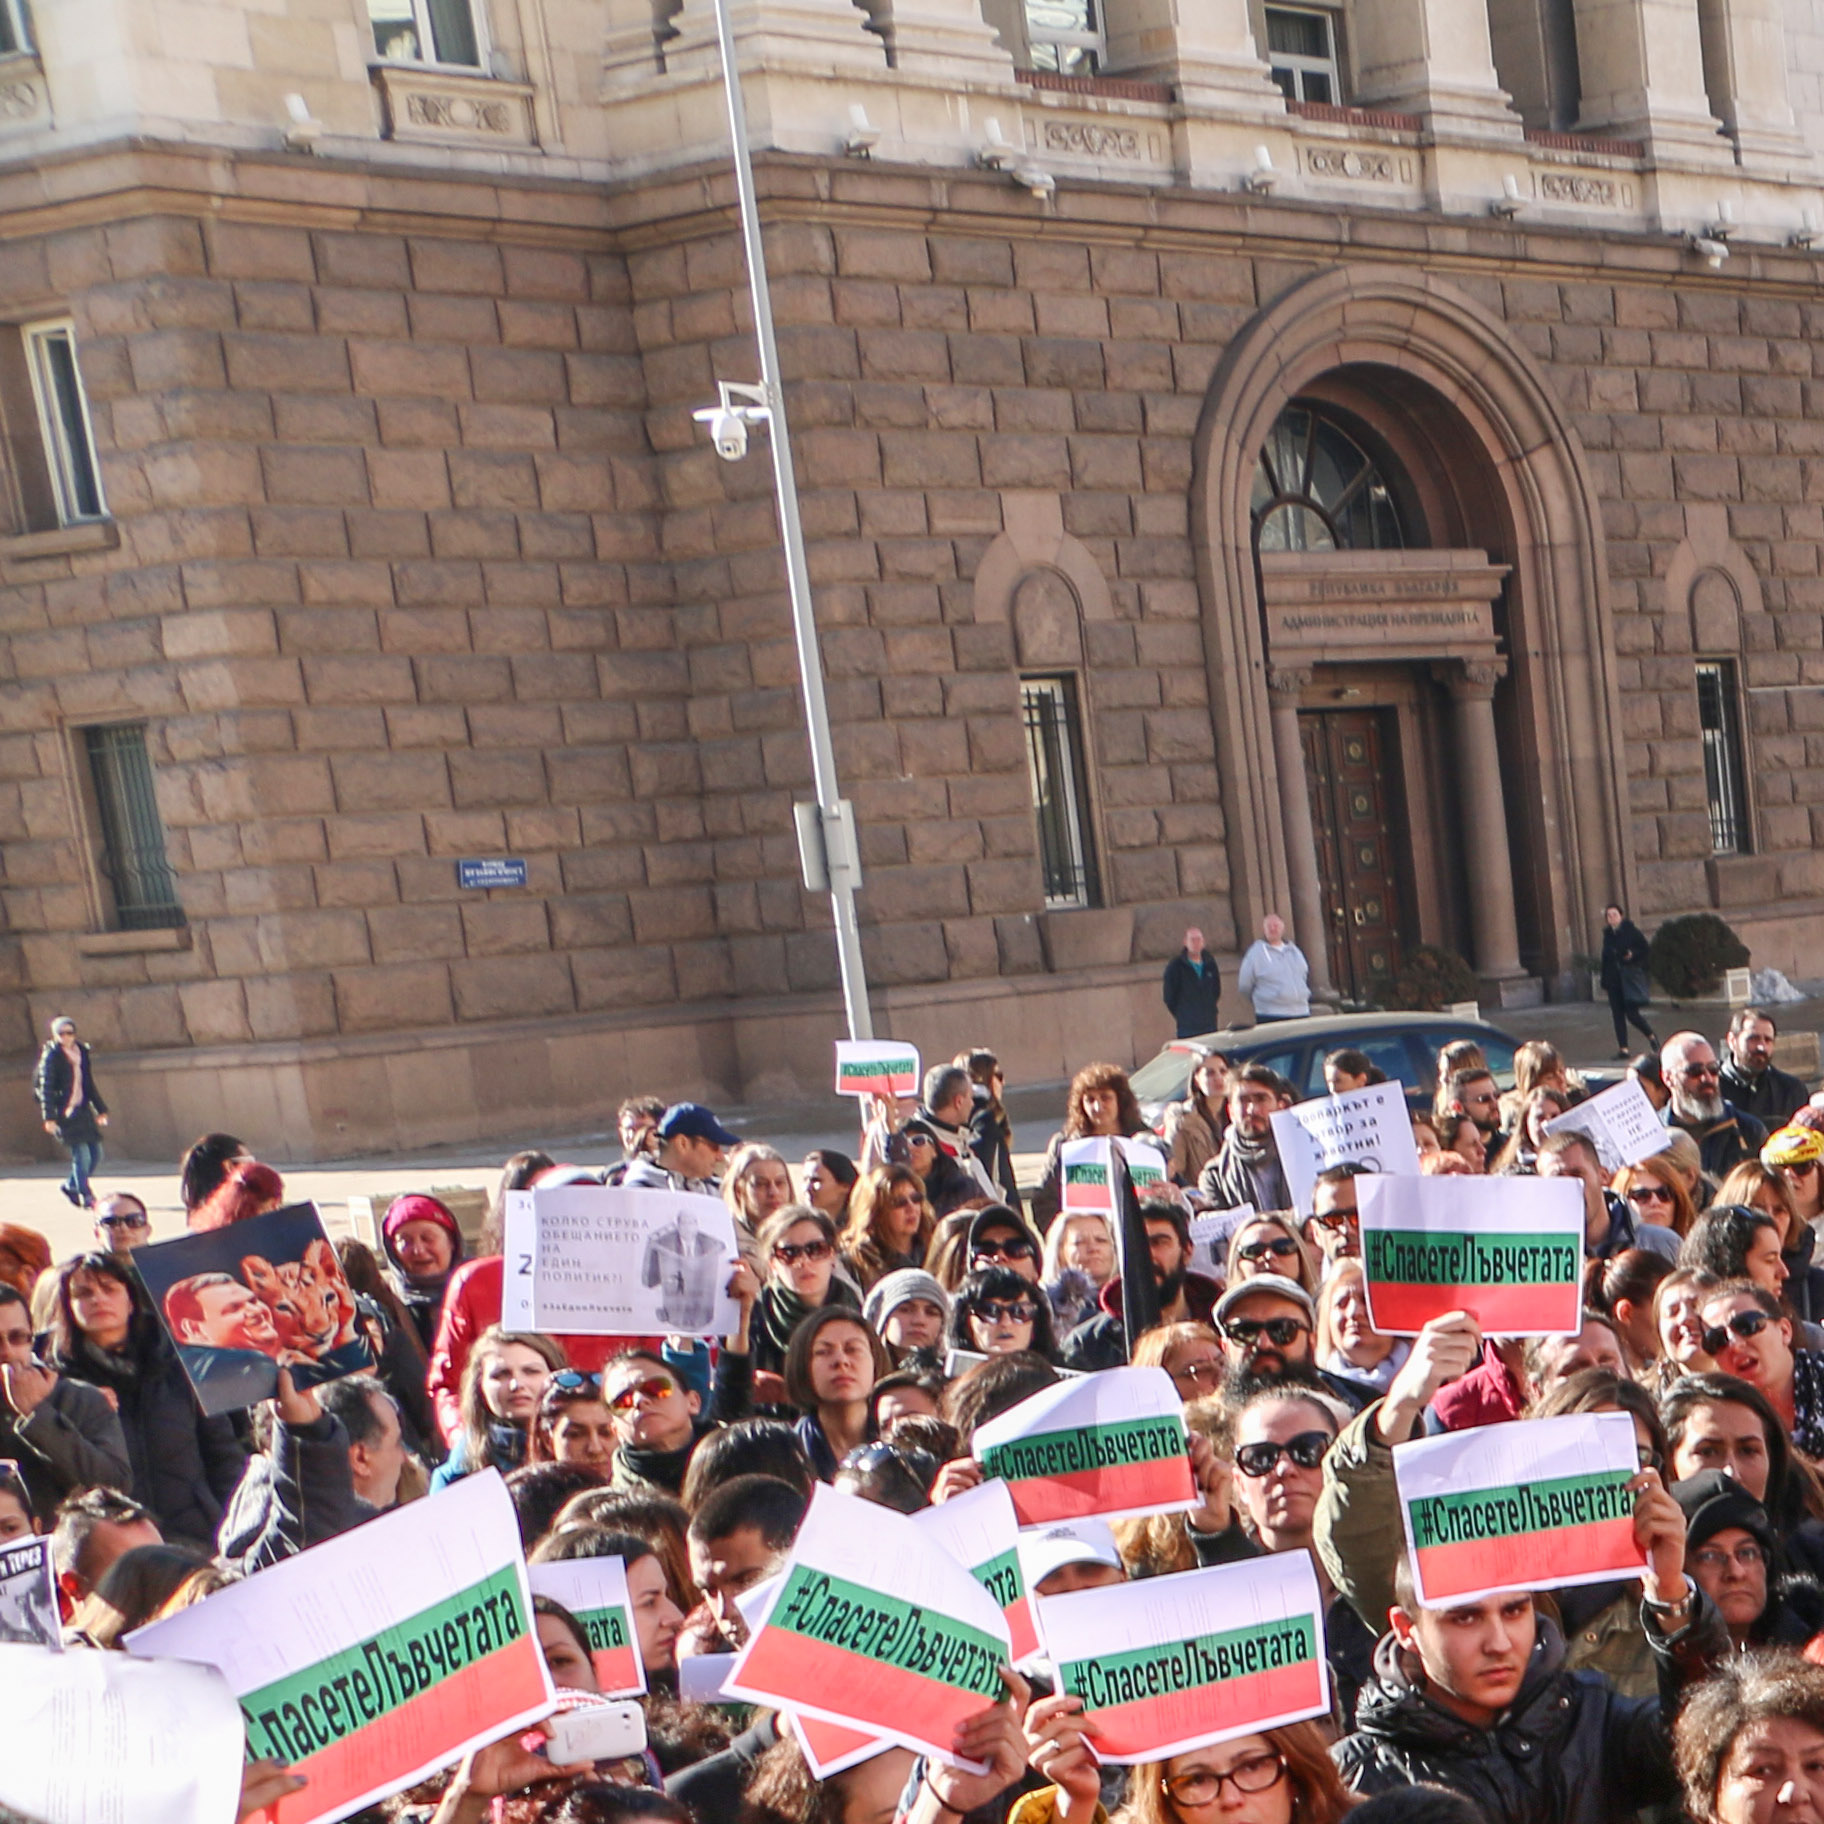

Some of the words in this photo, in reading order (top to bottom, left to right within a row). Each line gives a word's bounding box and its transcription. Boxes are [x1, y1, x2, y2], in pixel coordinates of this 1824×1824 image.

[542, 1216, 591, 1227] КОЛКО
[596, 1217, 650, 1229] СТРУВА
[542, 1230, 641, 1243] ОБЕЩАНИЕТО
[542, 1244, 561, 1254] НА
[542, 1258, 581, 1268] ЕДИН
[1368, 1233, 1578, 1288] #СпасетеЛъвчетата
[988, 1425, 1182, 1482] #СпасетеЛъвчетата
[1422, 1483, 1634, 1552] #СпасетеЛъвчетата
[243, 1586, 522, 1761] СпасетеЛъвчетата
[1073, 1633, 1308, 1712] #СпасетеЛъвчетата
